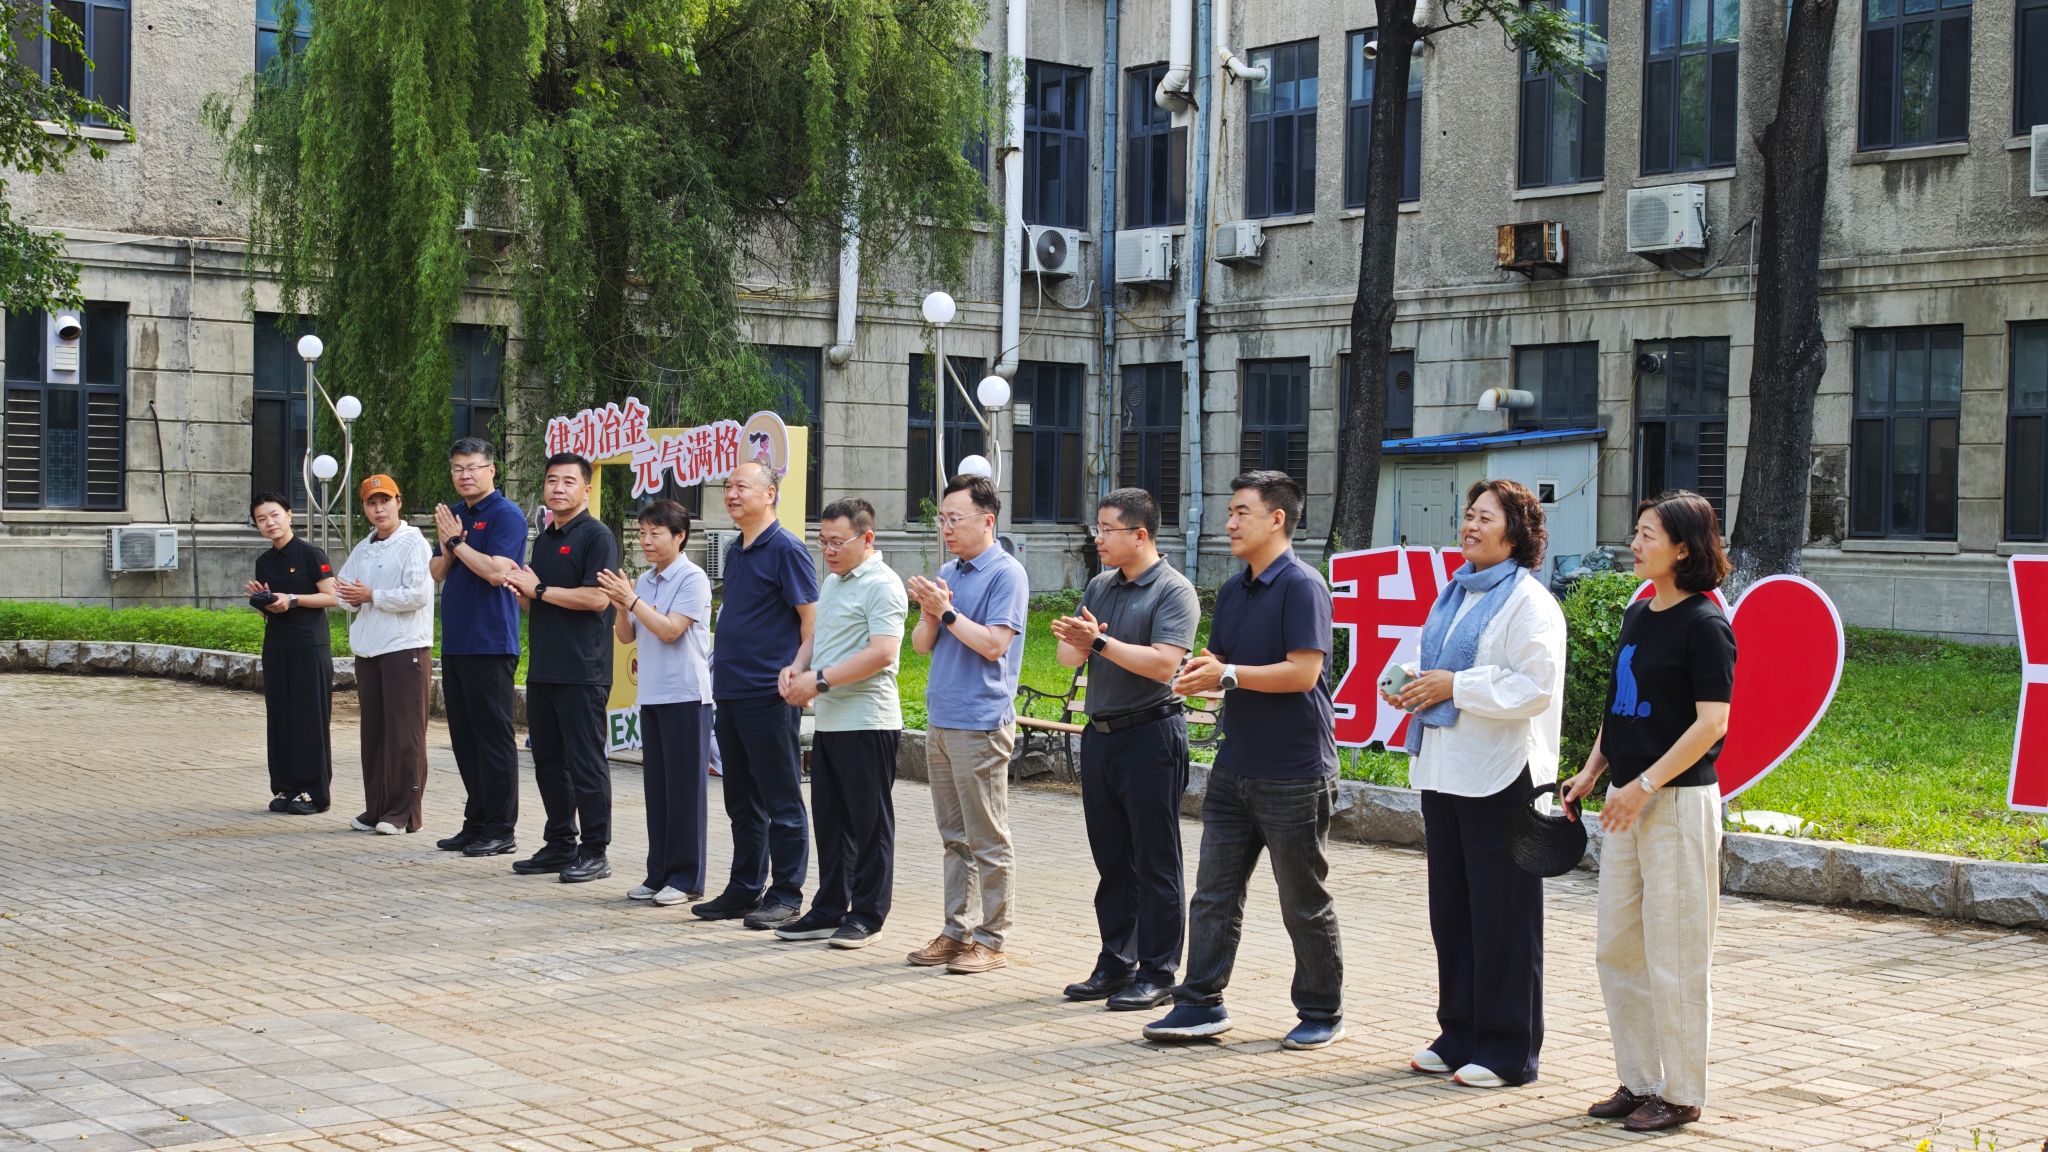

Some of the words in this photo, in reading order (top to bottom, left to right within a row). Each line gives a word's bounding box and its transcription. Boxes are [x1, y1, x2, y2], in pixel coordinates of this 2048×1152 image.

[548, 402, 646, 457] 律动冶金
[634, 425, 739, 493] 元气满格
